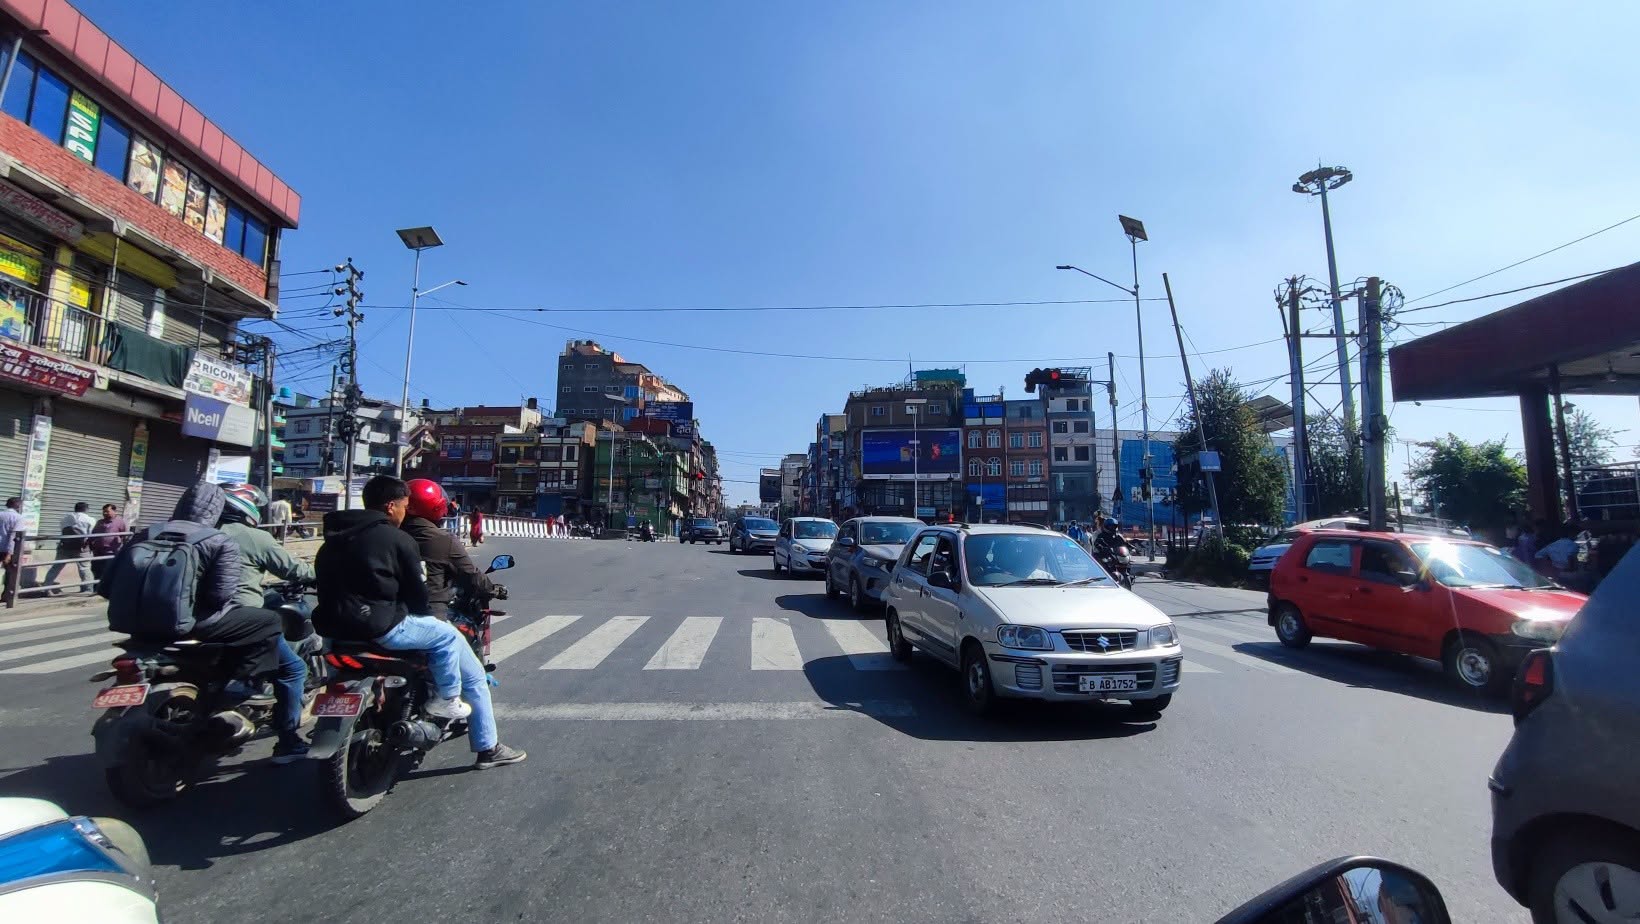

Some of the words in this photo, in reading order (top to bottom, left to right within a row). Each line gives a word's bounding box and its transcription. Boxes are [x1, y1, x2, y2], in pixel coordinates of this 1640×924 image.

[187, 407, 220, 428] Ncell
[1089, 680, 1096, 690] B
[1099, 679, 1134, 689] AB1752
